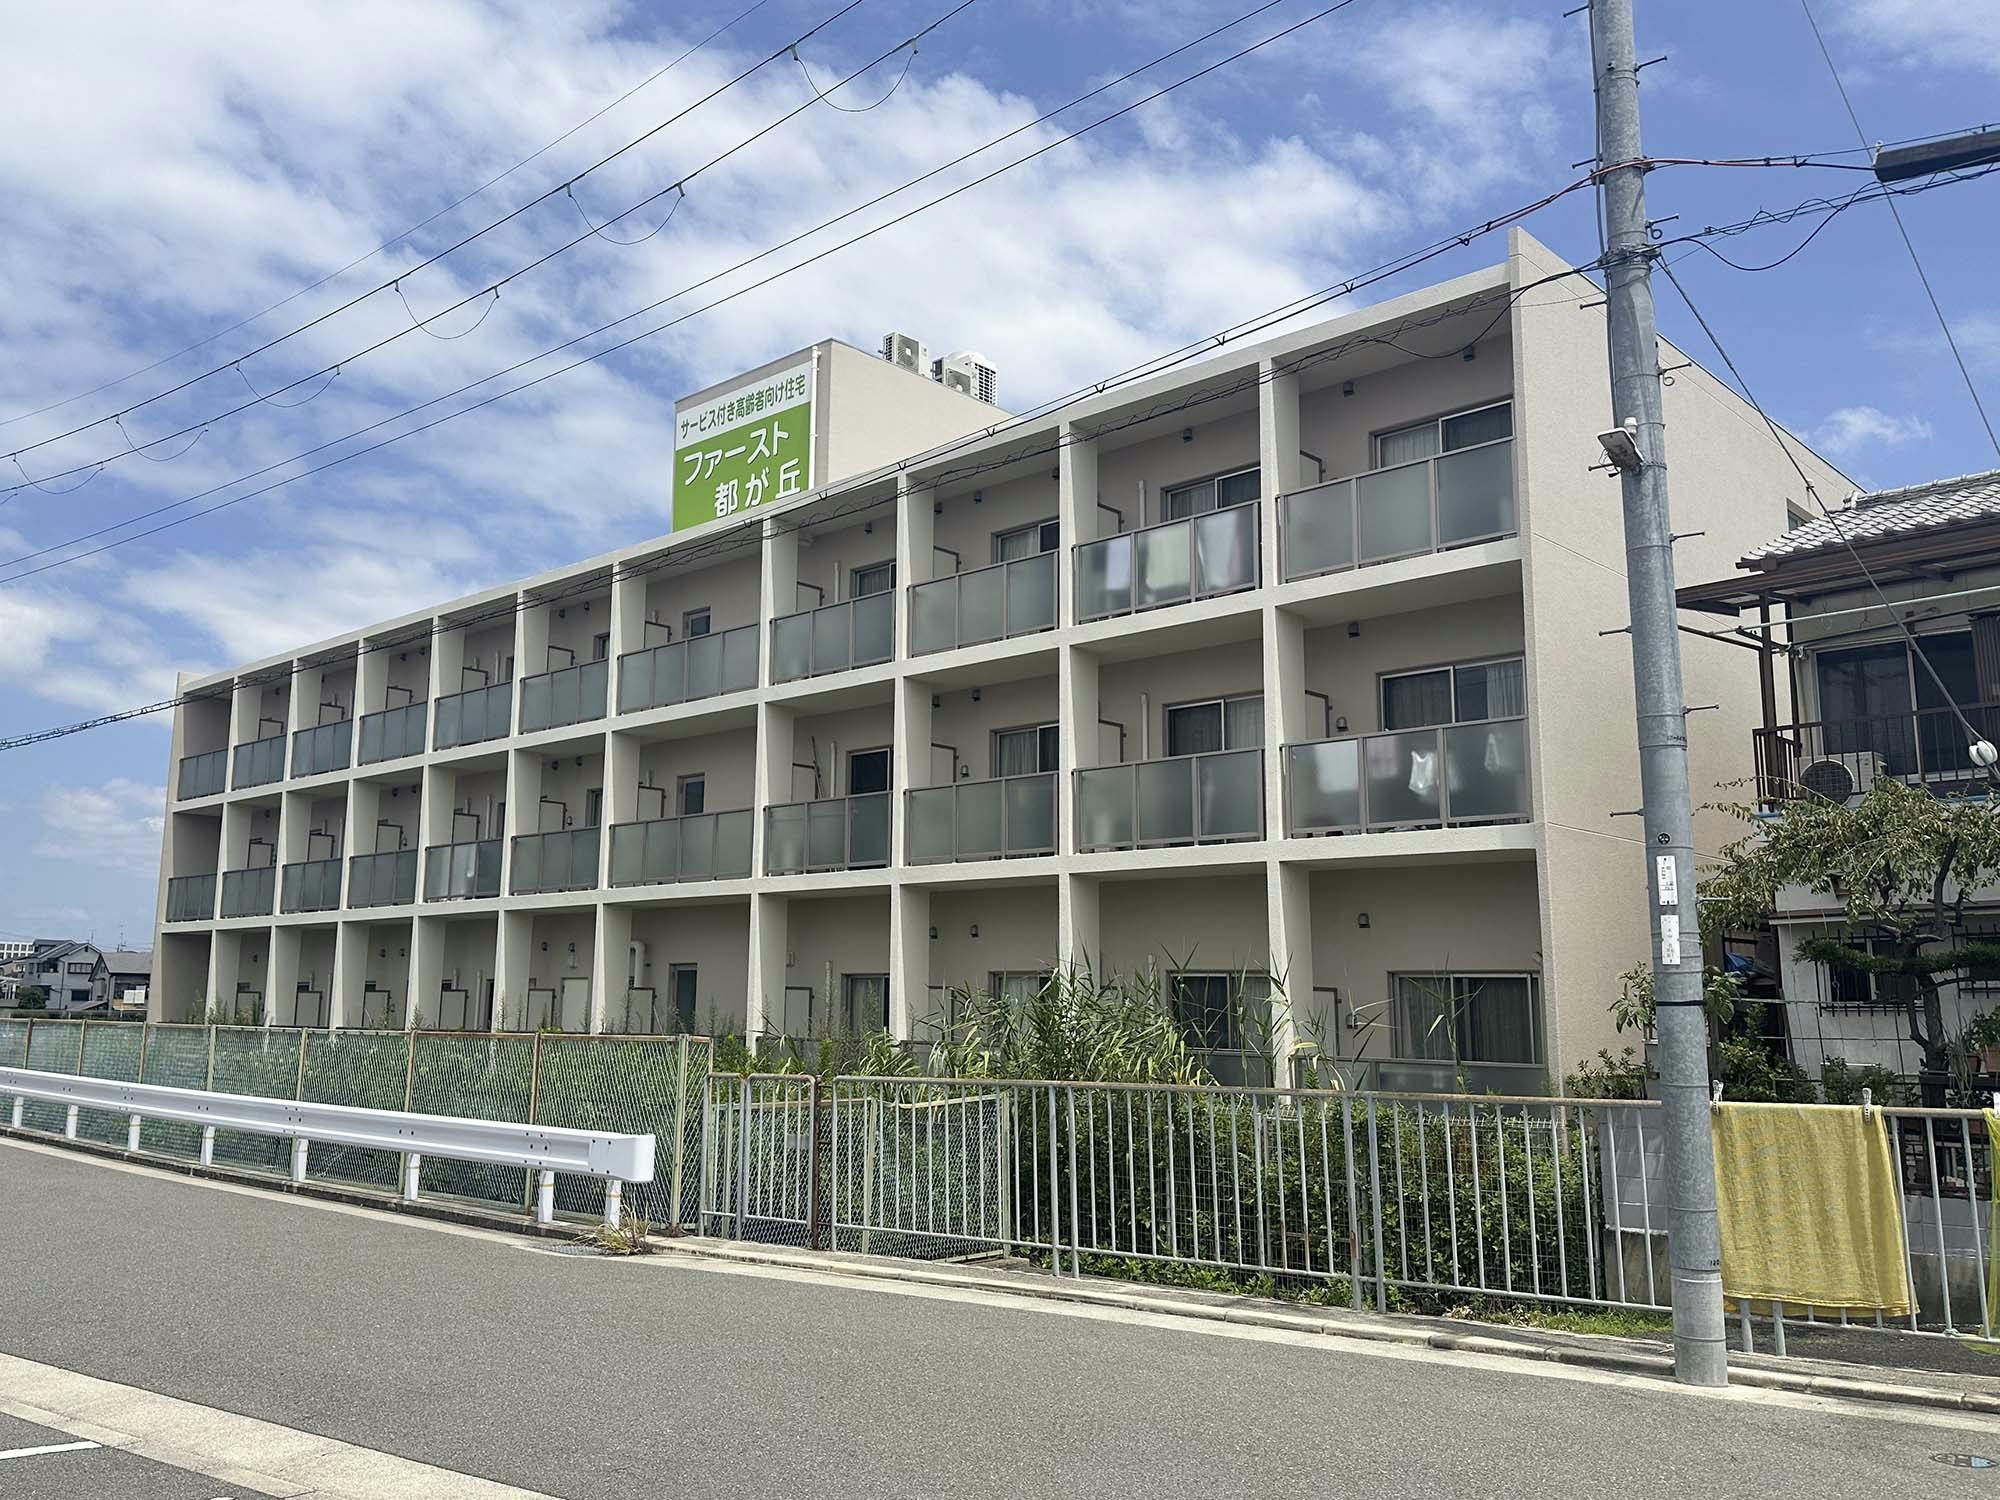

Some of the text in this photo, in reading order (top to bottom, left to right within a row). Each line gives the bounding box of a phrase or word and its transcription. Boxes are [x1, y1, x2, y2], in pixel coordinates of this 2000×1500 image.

[681, 374, 805, 439] サービス付き高齢者向け住宅
[684, 421, 789, 486] ファースト
[714, 458, 801, 517] 都が丘
